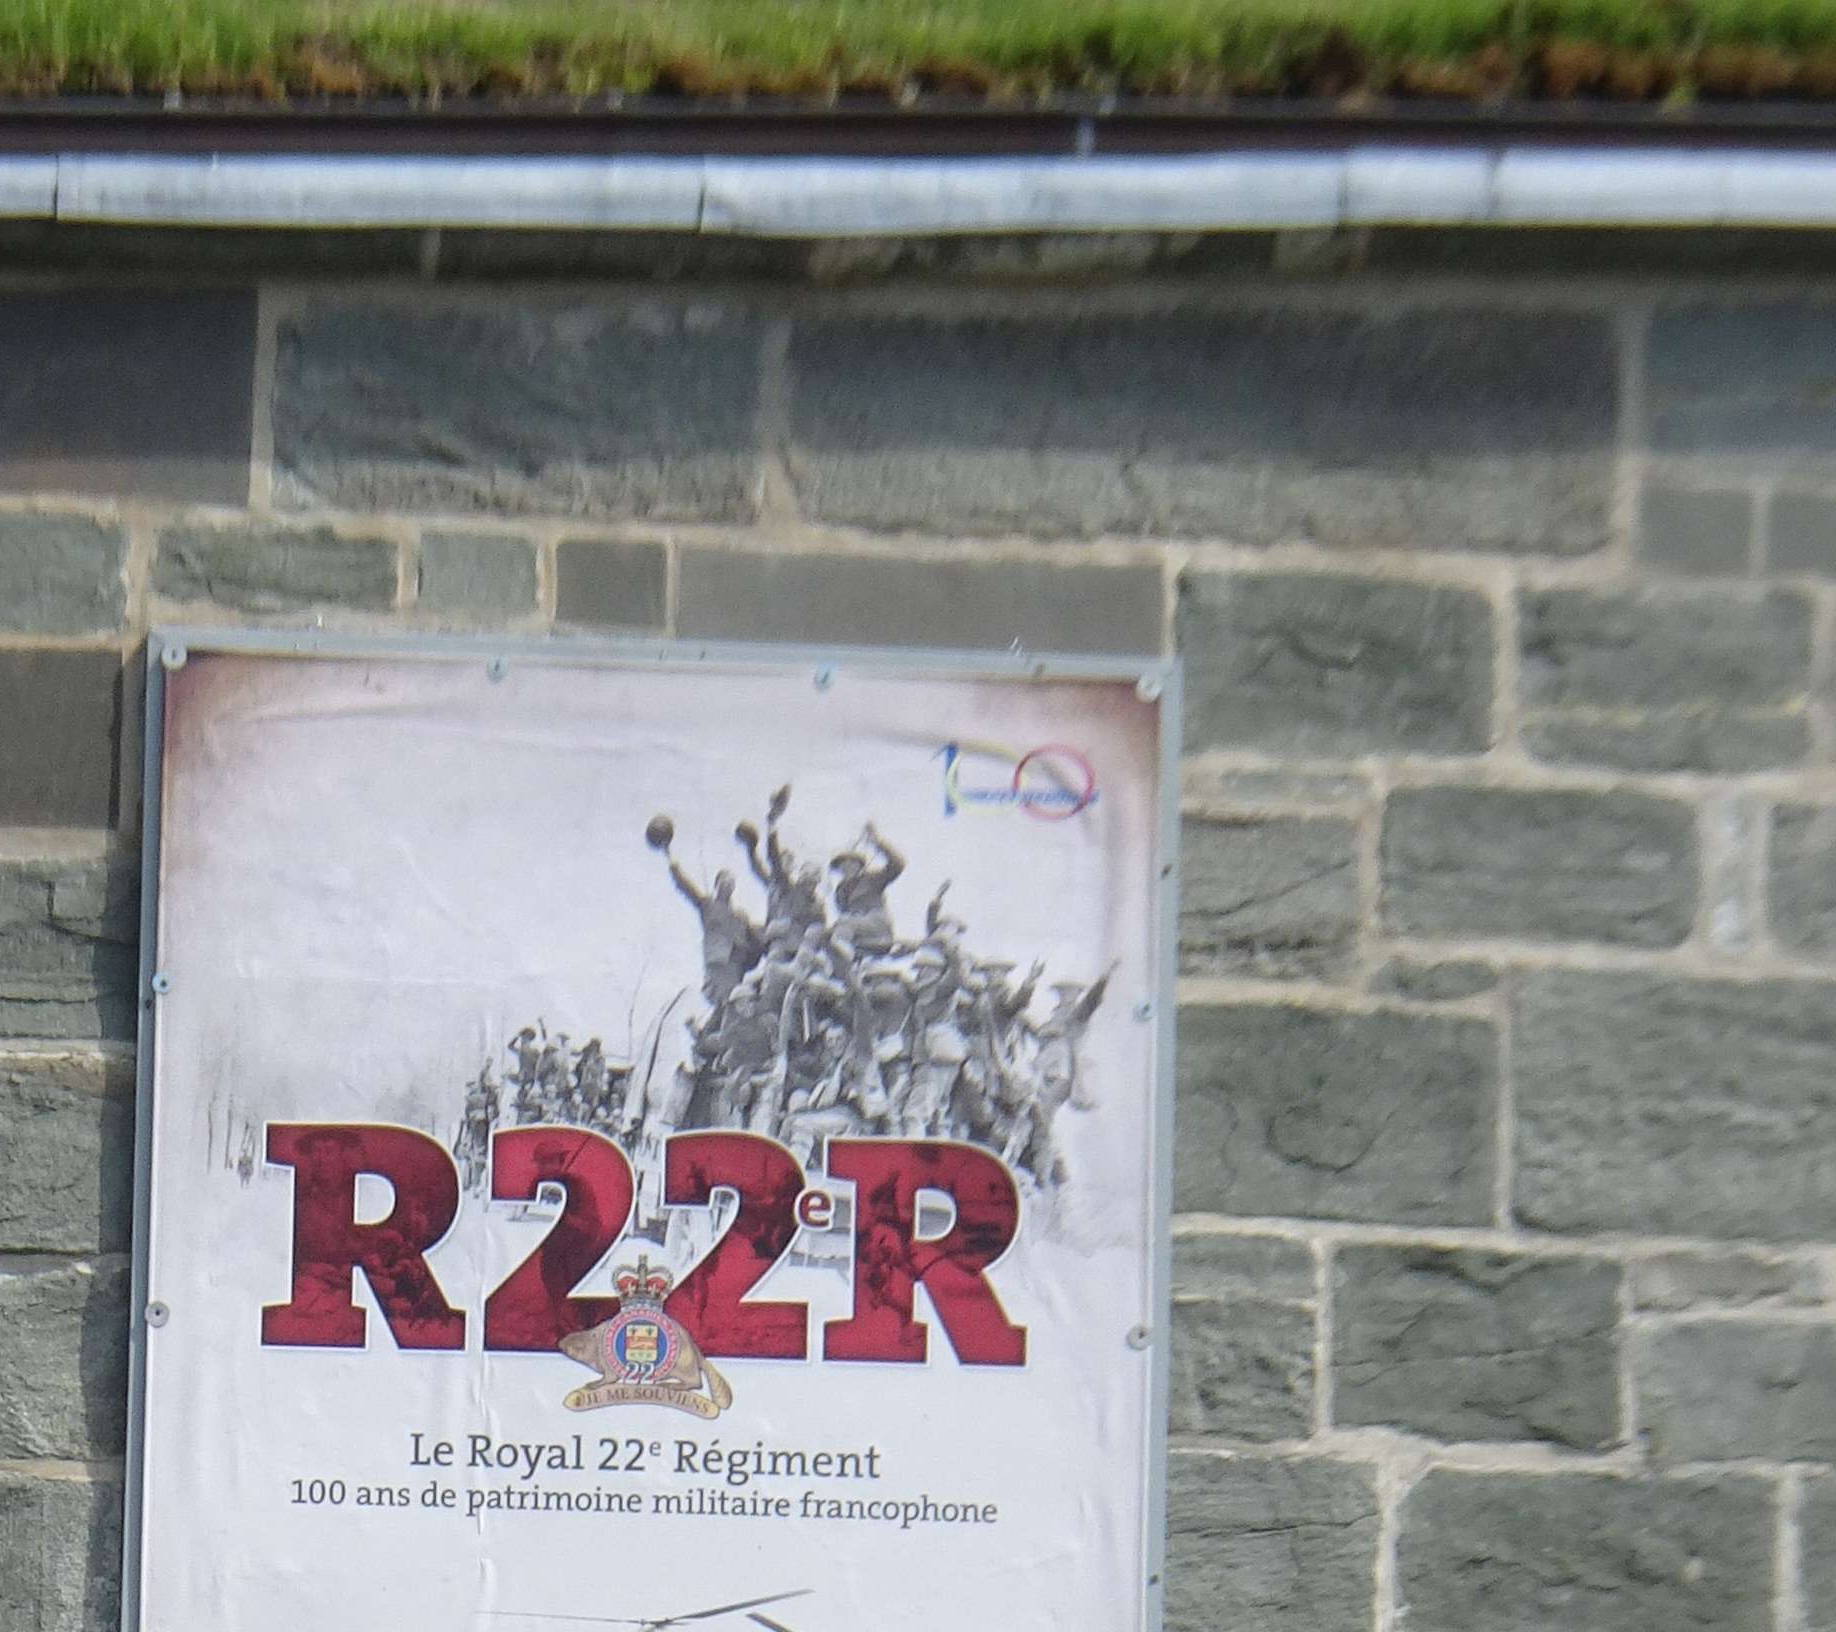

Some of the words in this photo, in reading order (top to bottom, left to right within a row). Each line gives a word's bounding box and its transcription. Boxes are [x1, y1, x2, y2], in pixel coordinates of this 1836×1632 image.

[624, 1361, 658, 1386] 22
[410, 1433, 454, 1467] Le
[467, 1434, 585, 1480] Royal
[674, 1438, 882, 1486] Régiment
[291, 1479, 346, 1504] 100
[356, 1486, 411, 1507] ans
[421, 1481, 457, 1508] de
[466, 1485, 642, 1517] patrimoine
[652, 1488, 791, 1518] militaire
[800, 1491, 998, 1529] francophone
